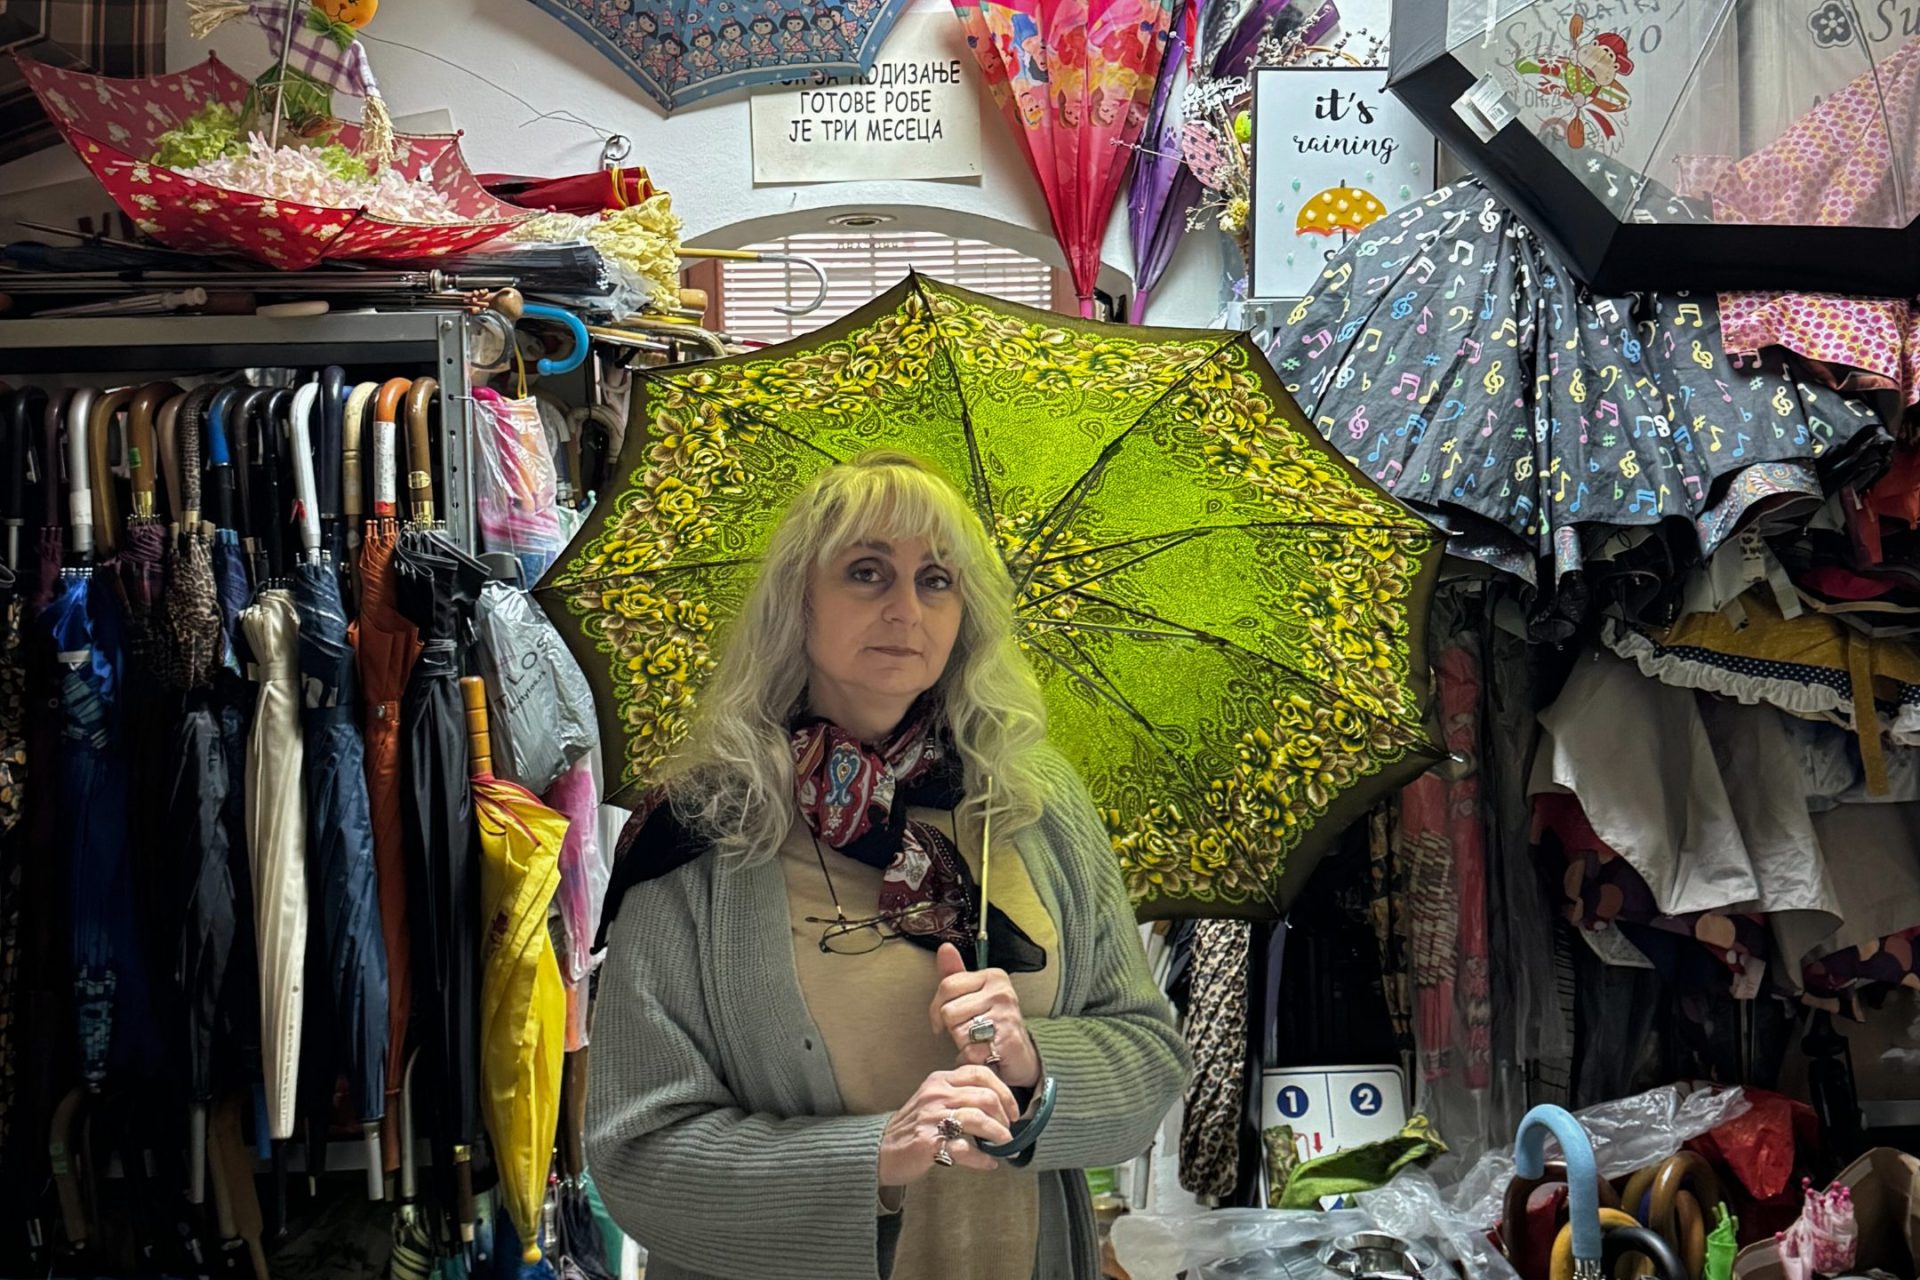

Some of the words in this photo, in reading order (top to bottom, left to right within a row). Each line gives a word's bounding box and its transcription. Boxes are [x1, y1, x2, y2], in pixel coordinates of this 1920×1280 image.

[799, 91, 876, 114] ГОТОВЕ
[885, 89, 932, 113] РОБЕ
[1314, 88, 1378, 124] it's
[788, 119, 812, 142] ЈЕ
[820, 119, 858, 142] ТРИ
[866, 117, 943, 144] МЕСЕЦА
[1292, 134, 1400, 165] raining
[1285, 1090, 1298, 1113] 1
[1358, 1088, 1376, 1111] 2
